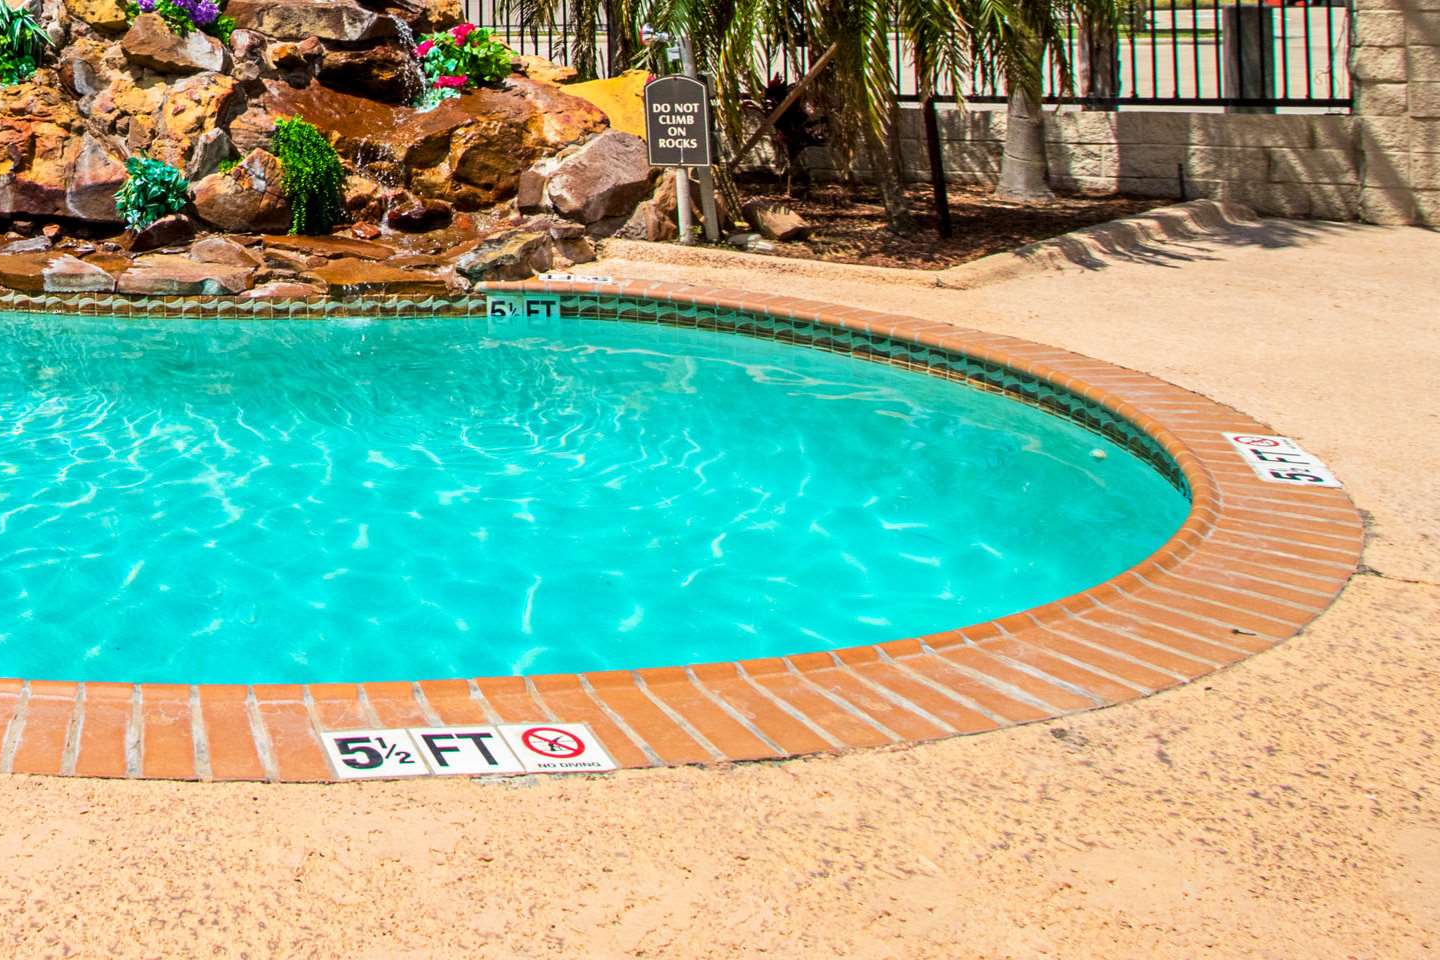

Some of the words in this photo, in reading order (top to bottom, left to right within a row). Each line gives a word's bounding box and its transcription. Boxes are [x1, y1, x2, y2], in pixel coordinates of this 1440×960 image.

[652, 103, 671, 113] DO
[674, 103, 700, 113] NOT
[658, 115, 695, 125] CLIMB
[667, 127, 687, 137] ON
[658, 138, 698, 149] ROCKS
[526, 300, 556, 318] FT
[1249, 448, 1311, 465] FT
[421, 732, 500, 768] FT
